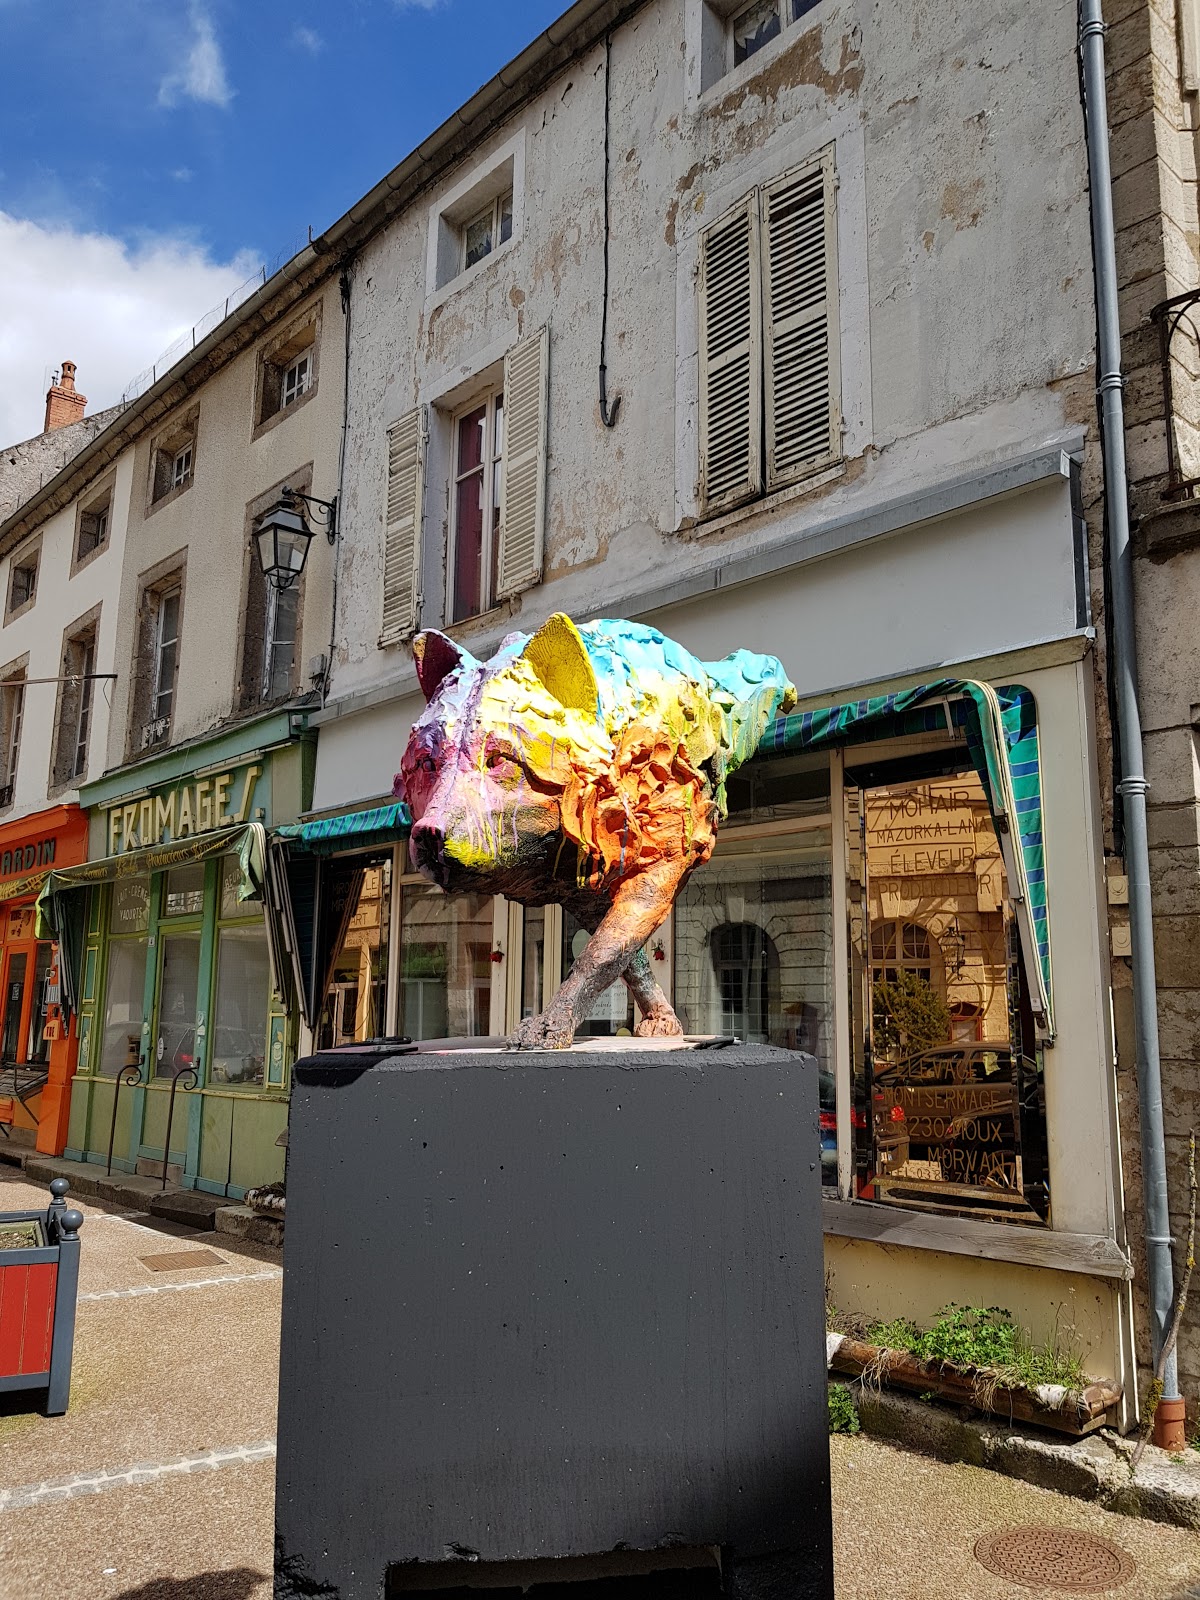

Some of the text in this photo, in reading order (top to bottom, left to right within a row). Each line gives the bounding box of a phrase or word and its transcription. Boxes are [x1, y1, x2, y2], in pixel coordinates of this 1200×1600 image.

[877, 817, 988, 844] MAZURKA-LANA
[0, 839, 56, 876] ARDIN
[890, 848, 975, 874] ÉLEVEUR
[879, 874, 991, 902] PRODUCTEUR
[928, 1147, 1006, 1173] MORVAN
